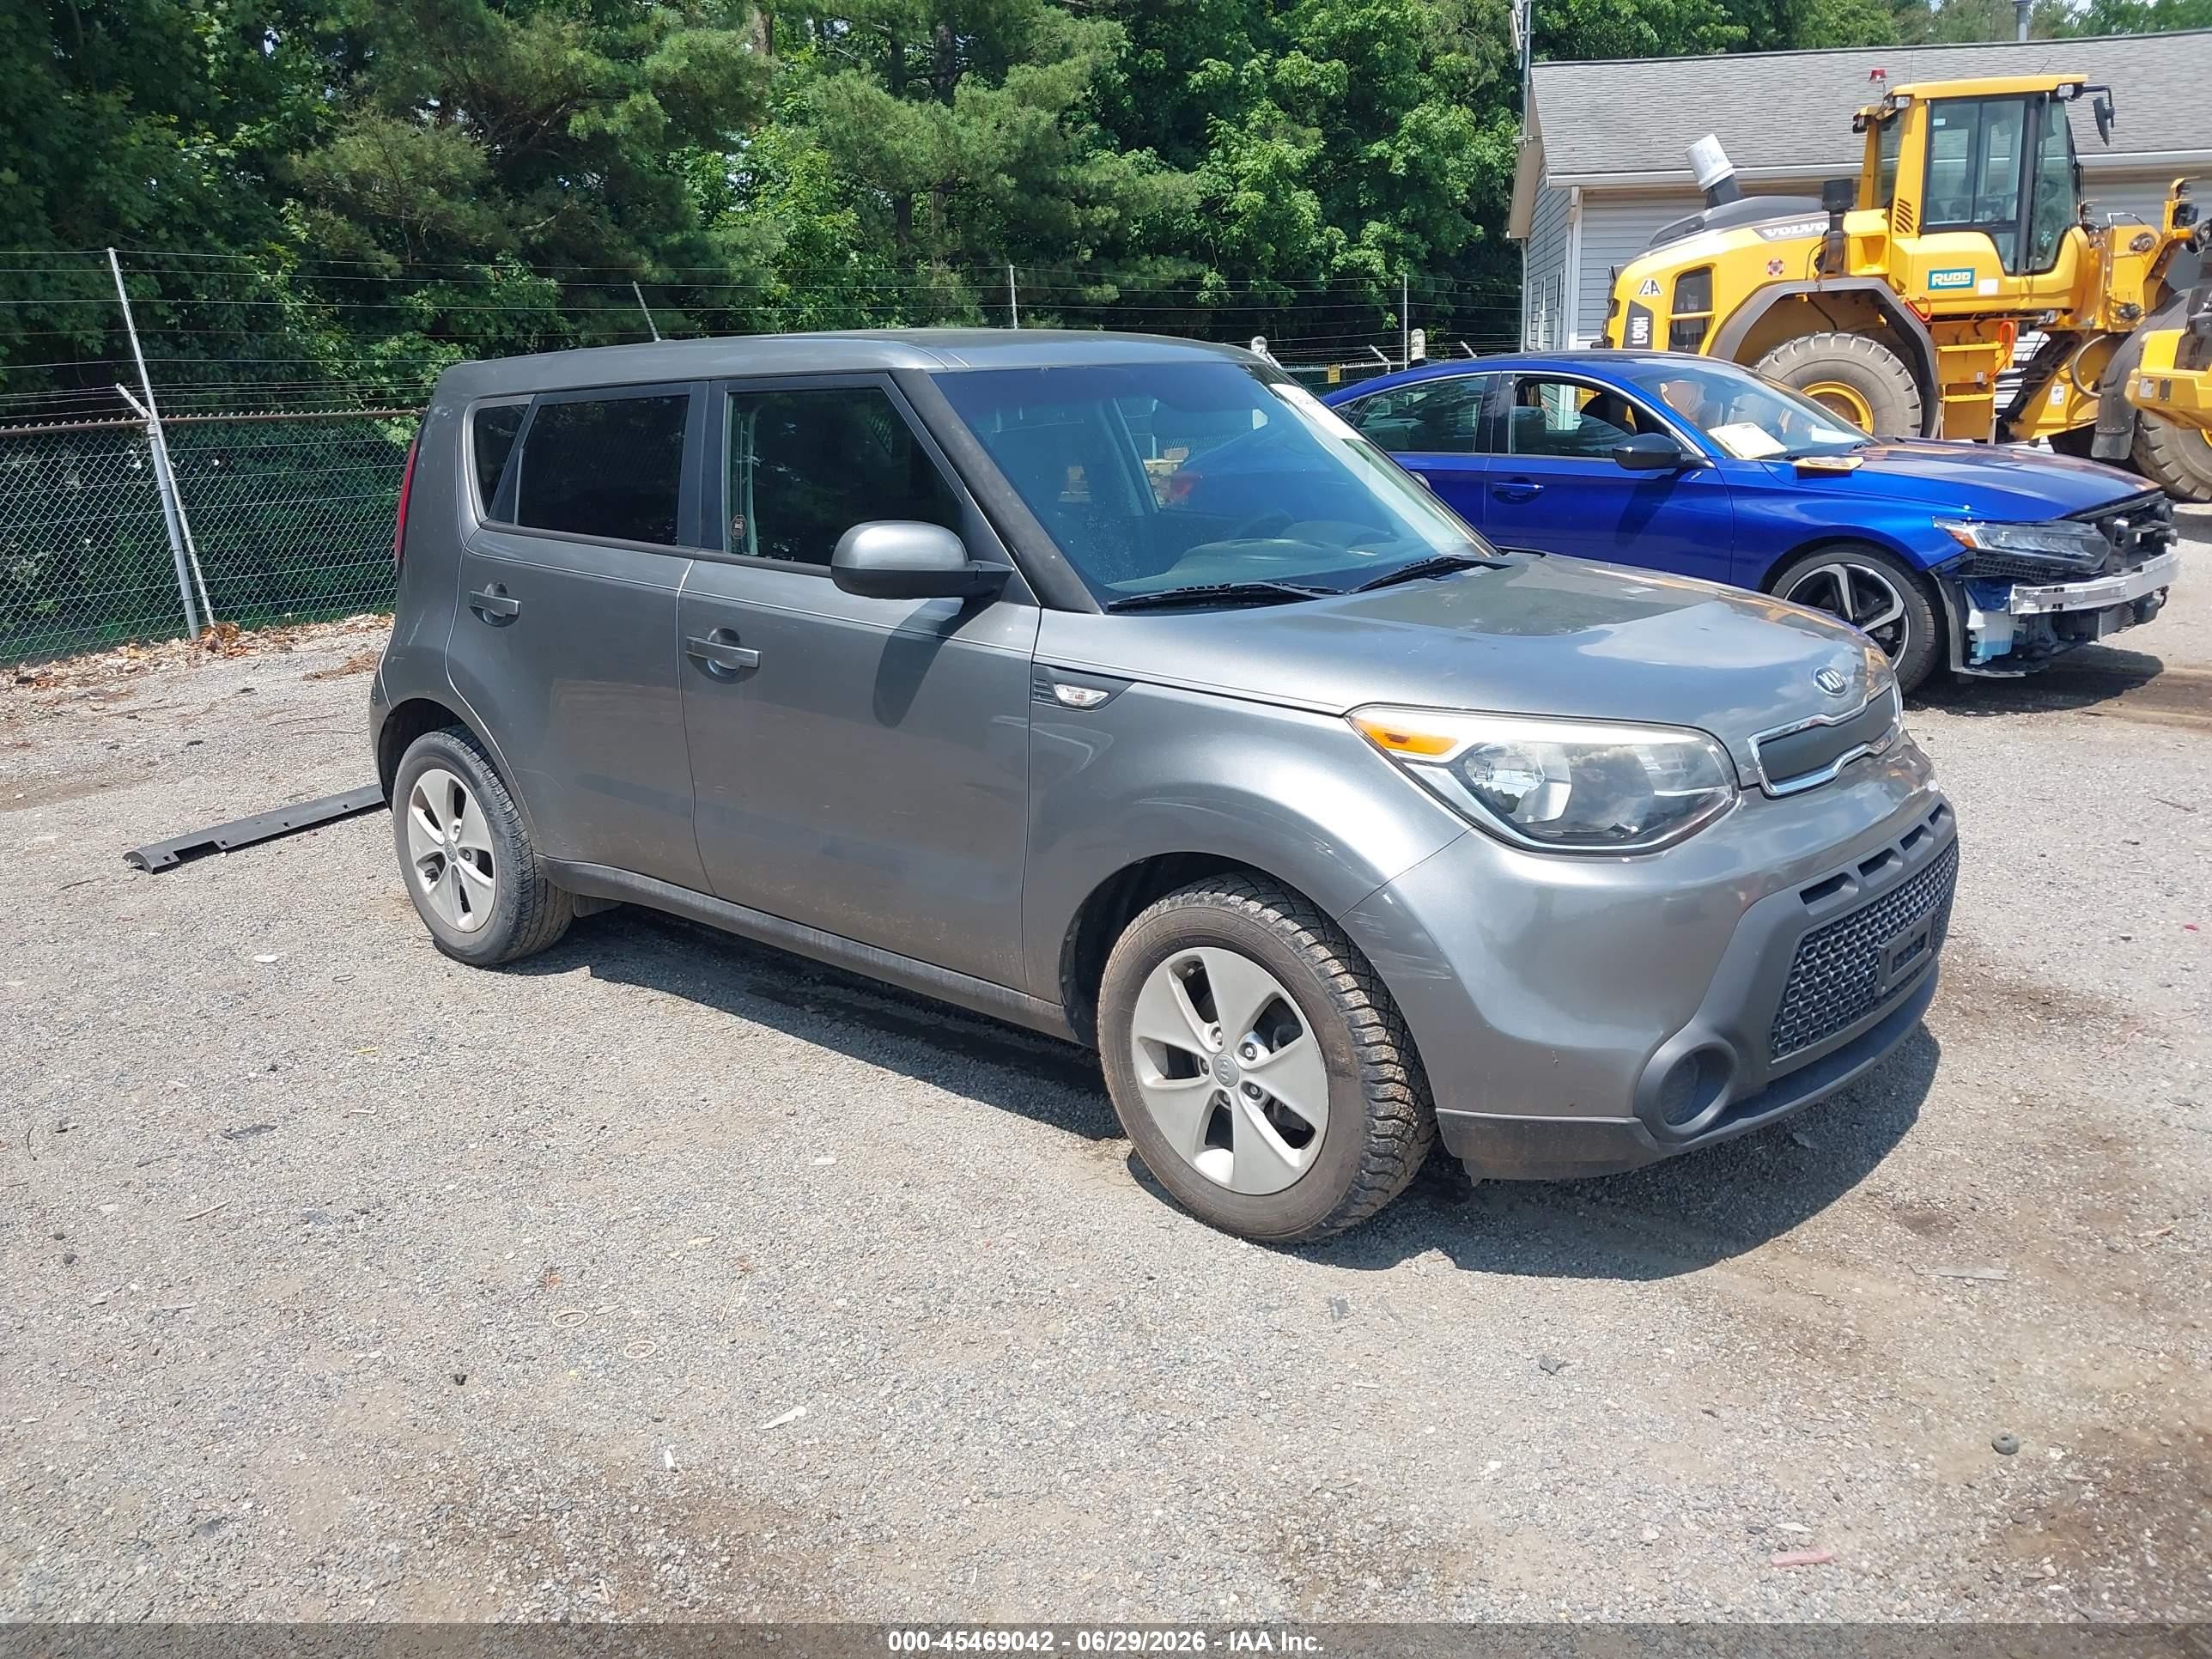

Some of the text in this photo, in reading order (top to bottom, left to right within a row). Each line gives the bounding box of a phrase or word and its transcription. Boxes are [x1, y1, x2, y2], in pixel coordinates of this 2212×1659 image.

[1763, 222, 1829, 237] VOLVO
[1632, 316, 1650, 344] L90H
[1817, 670, 1844, 691] KIA
